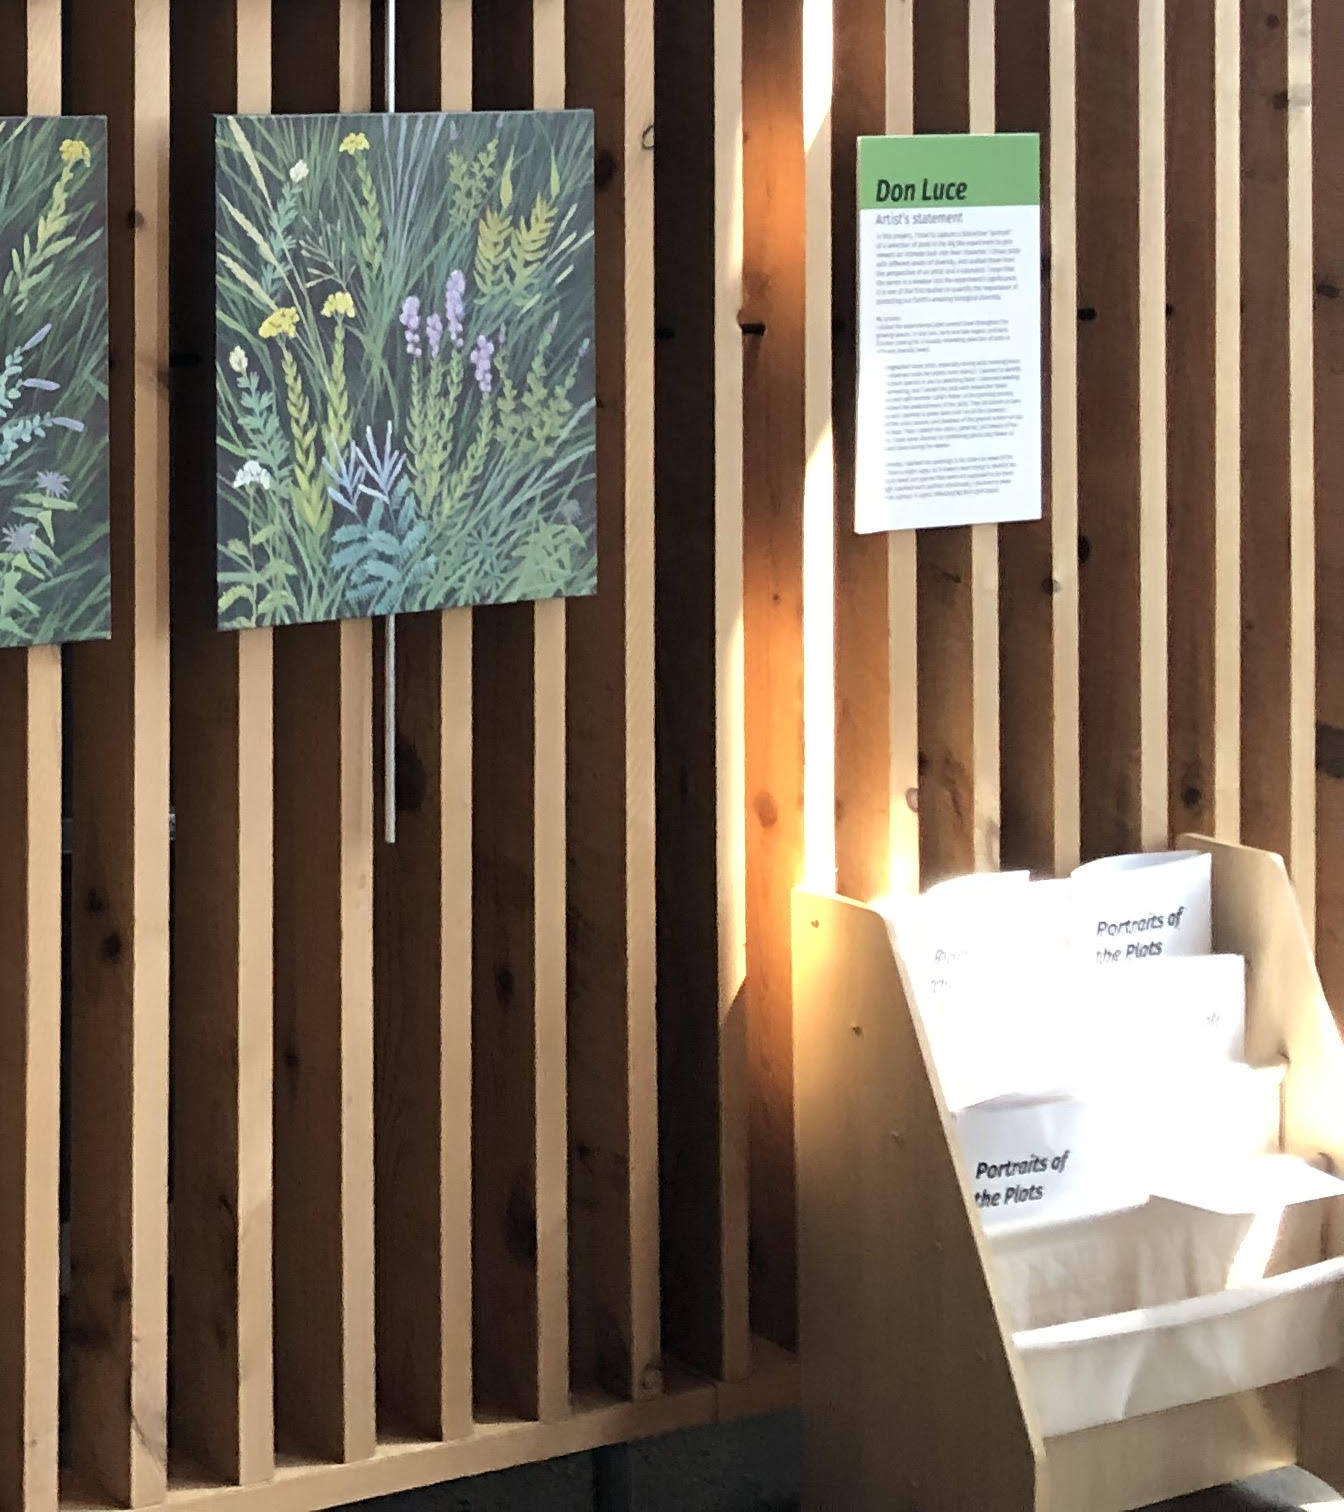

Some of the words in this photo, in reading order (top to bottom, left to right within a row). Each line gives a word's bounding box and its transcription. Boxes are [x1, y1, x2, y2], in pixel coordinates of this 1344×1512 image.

[875, 179, 916, 202] Don
[921, 178, 968, 201] Luce
[912, 212, 963, 225] statement
[1096, 912, 1164, 937] Portraits
[1167, 906, 1185, 929] of
[1126, 941, 1163, 959] Plots
[975, 1153, 1047, 1180] Portraits
[1051, 1149, 1071, 1174] of
[1004, 1184, 1044, 1206] Plots
